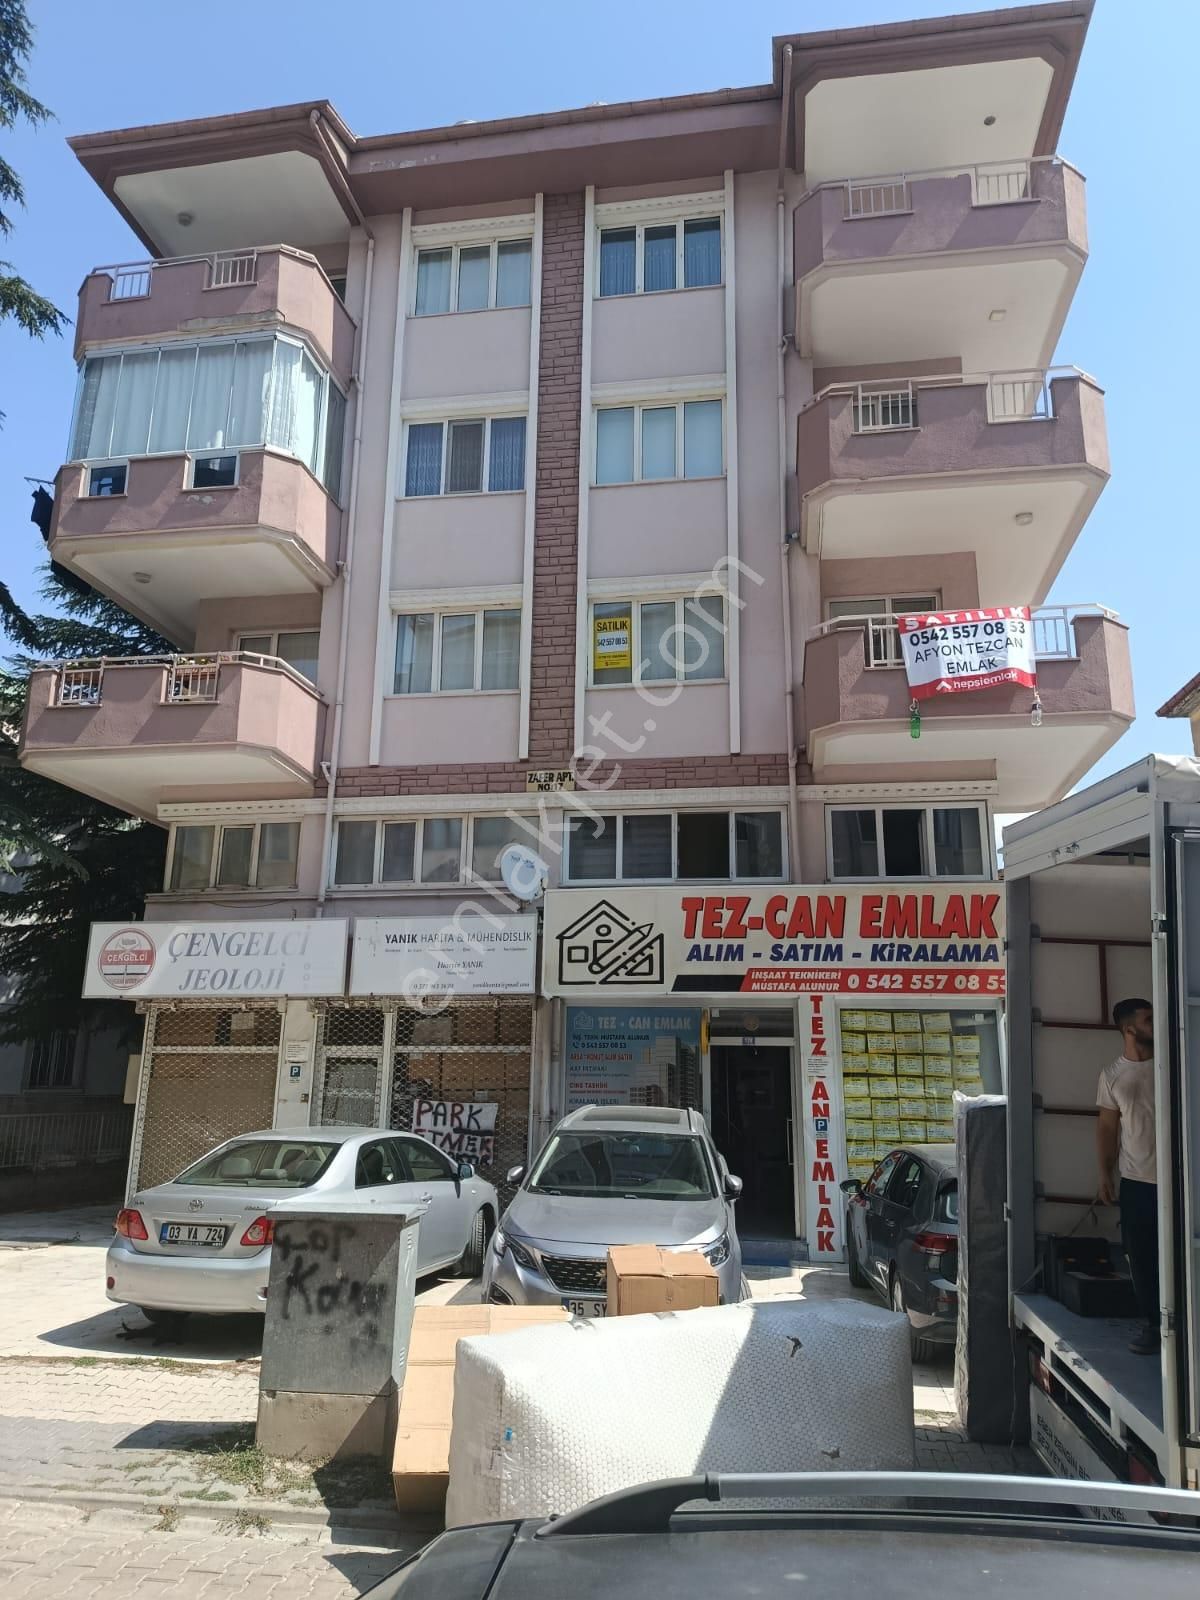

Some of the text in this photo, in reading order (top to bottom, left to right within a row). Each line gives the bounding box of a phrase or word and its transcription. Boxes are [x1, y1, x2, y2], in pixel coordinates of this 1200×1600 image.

[596, 620, 628, 631] SATILIK
[905, 607, 1026, 630] SATILIK
[910, 621, 1026, 646] 0542 557 08 53
[915, 637, 1023, 663] AFYON TEZCAN
[946, 657, 998, 674] EMLAK
[953, 670, 1018, 689] hepsiemlak
[681, 894, 1001, 939] TEZ-CAN EMLAK
[168, 925, 312, 962] ÇENGELCİ
[385, 934, 418, 944] YANIK
[457, 934, 464, 942] &
[686, 944, 744, 962] ALIM
[769, 943, 843, 962] SATIM
[178, 963, 286, 991] JEOLOJİ
[751, 970, 842, 981] İNŞAAT TEKNİKERİ
[848, 974, 860, 989] 0
[866, 974, 903, 989] 542
[910, 974, 948, 990] 557
[954, 974, 980, 990] 08
[751, 982, 840, 991] MUSTAFA ALUNUR
[598, 1016, 617, 1029] TEZ
[629, 1016, 651, 1029] CAN
[654, 1016, 692, 1029] EMLAK
[416, 1100, 482, 1129] PARK
[812, 1139, 835, 1252] EMLAK
[168, 1226, 224, 1241] 03 VA 724
[570, 1302, 584, 1316] 35
